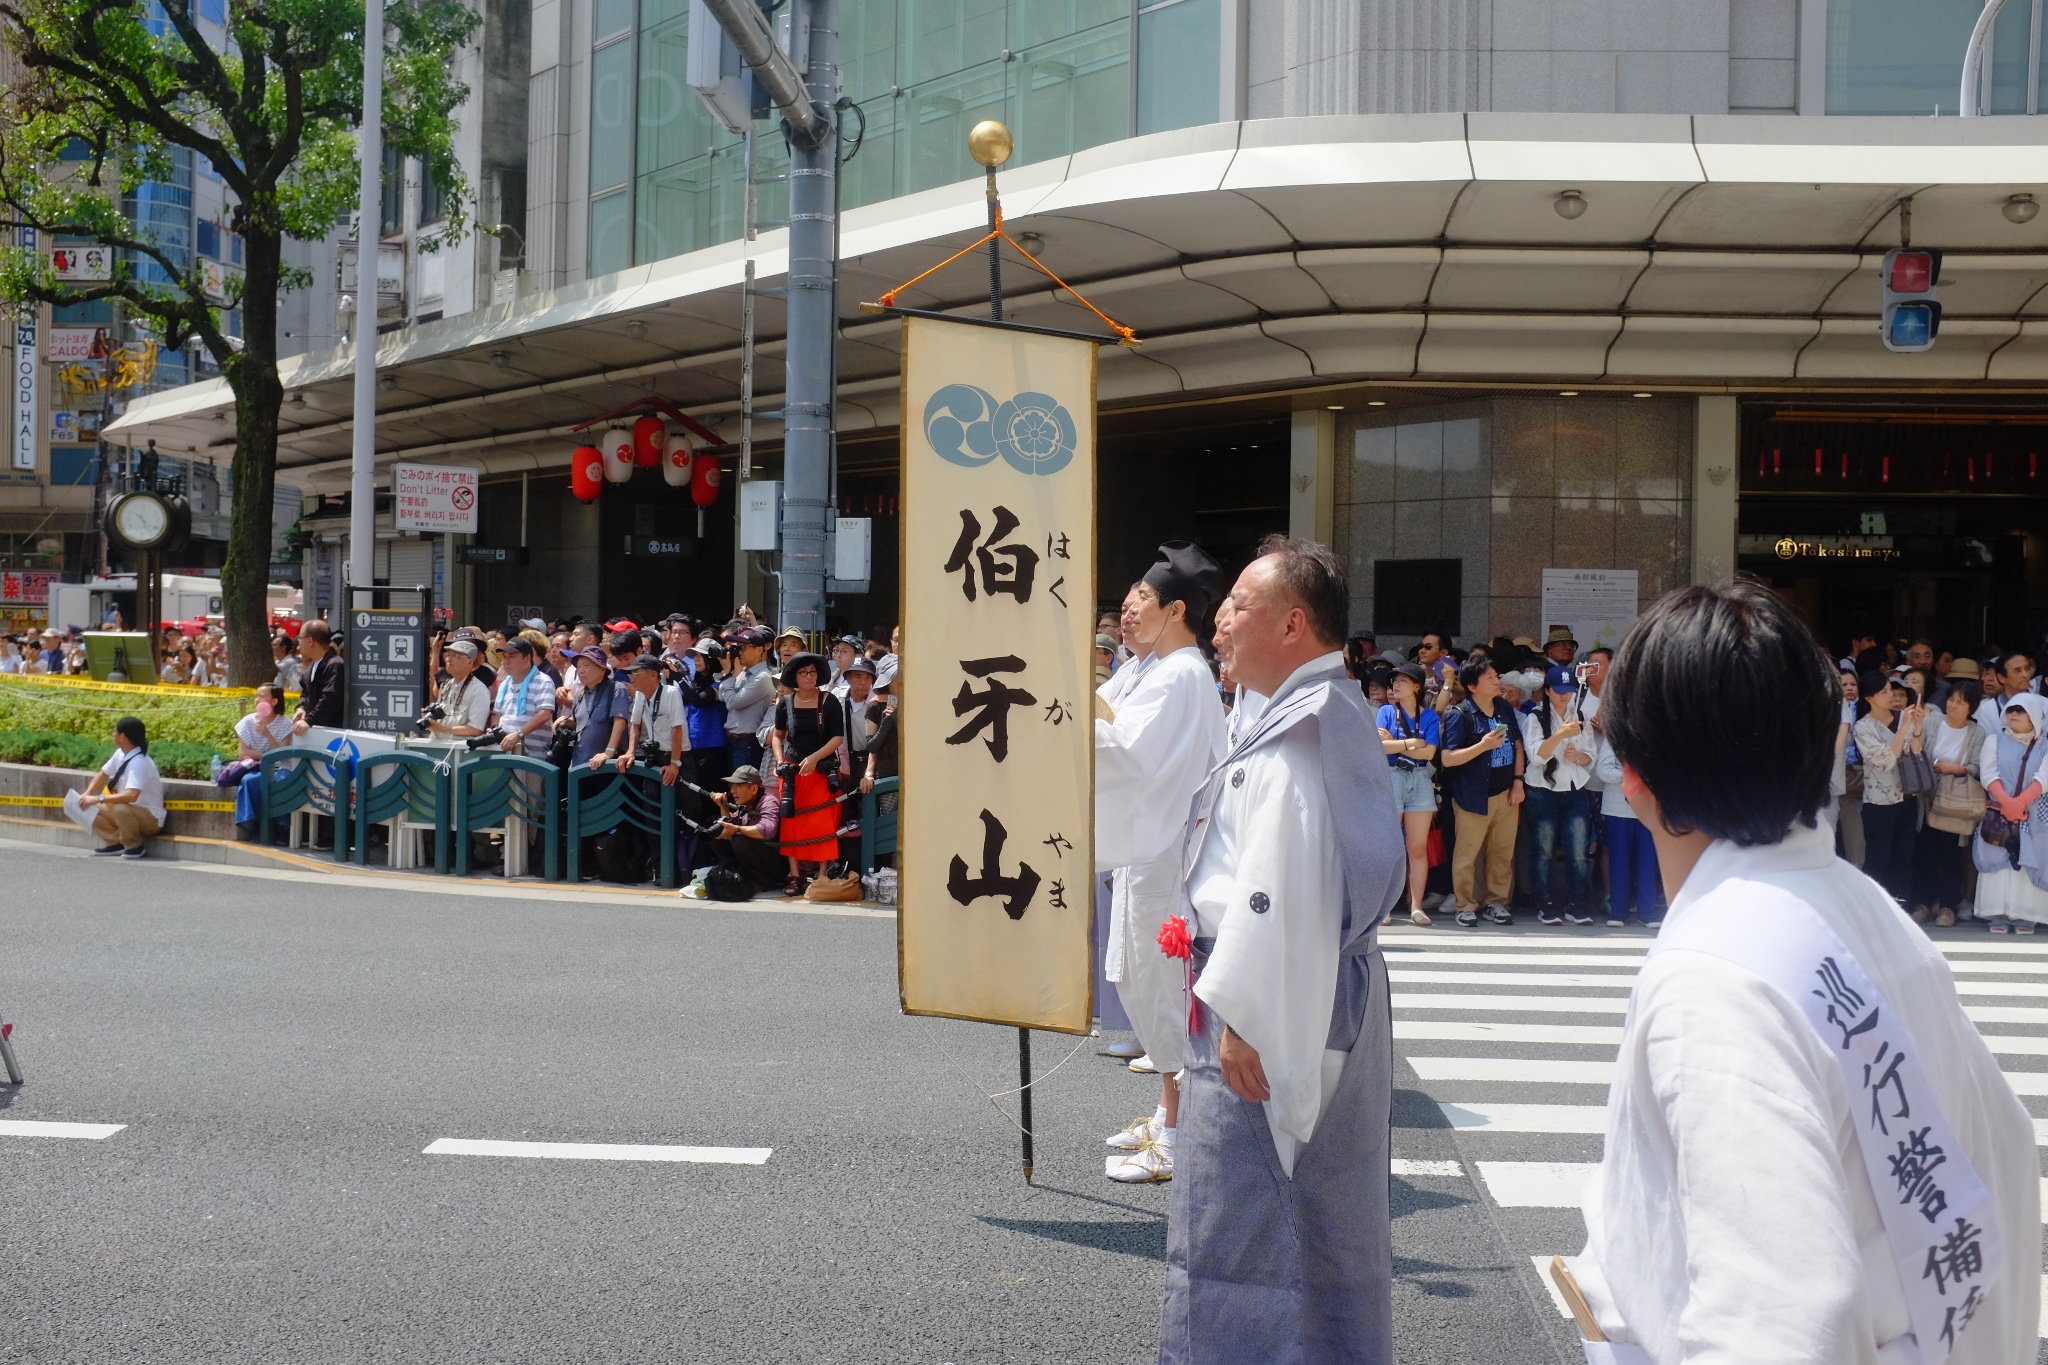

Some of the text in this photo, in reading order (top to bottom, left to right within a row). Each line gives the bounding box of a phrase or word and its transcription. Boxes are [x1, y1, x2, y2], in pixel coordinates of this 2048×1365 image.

[50, 345, 89, 356] CALDO
[20, 349, 33, 465] FOOD HALL
[401, 469, 475, 485] ごみのポイ捨て禁止
[400, 483, 449, 496] Don't Litter
[425, 510, 445, 521] 버리지
[1798, 542, 1901, 562] Takashimaya
[944, 505, 1041, 921] 伯牙山
[358, 719, 397, 730] 八坂神社
